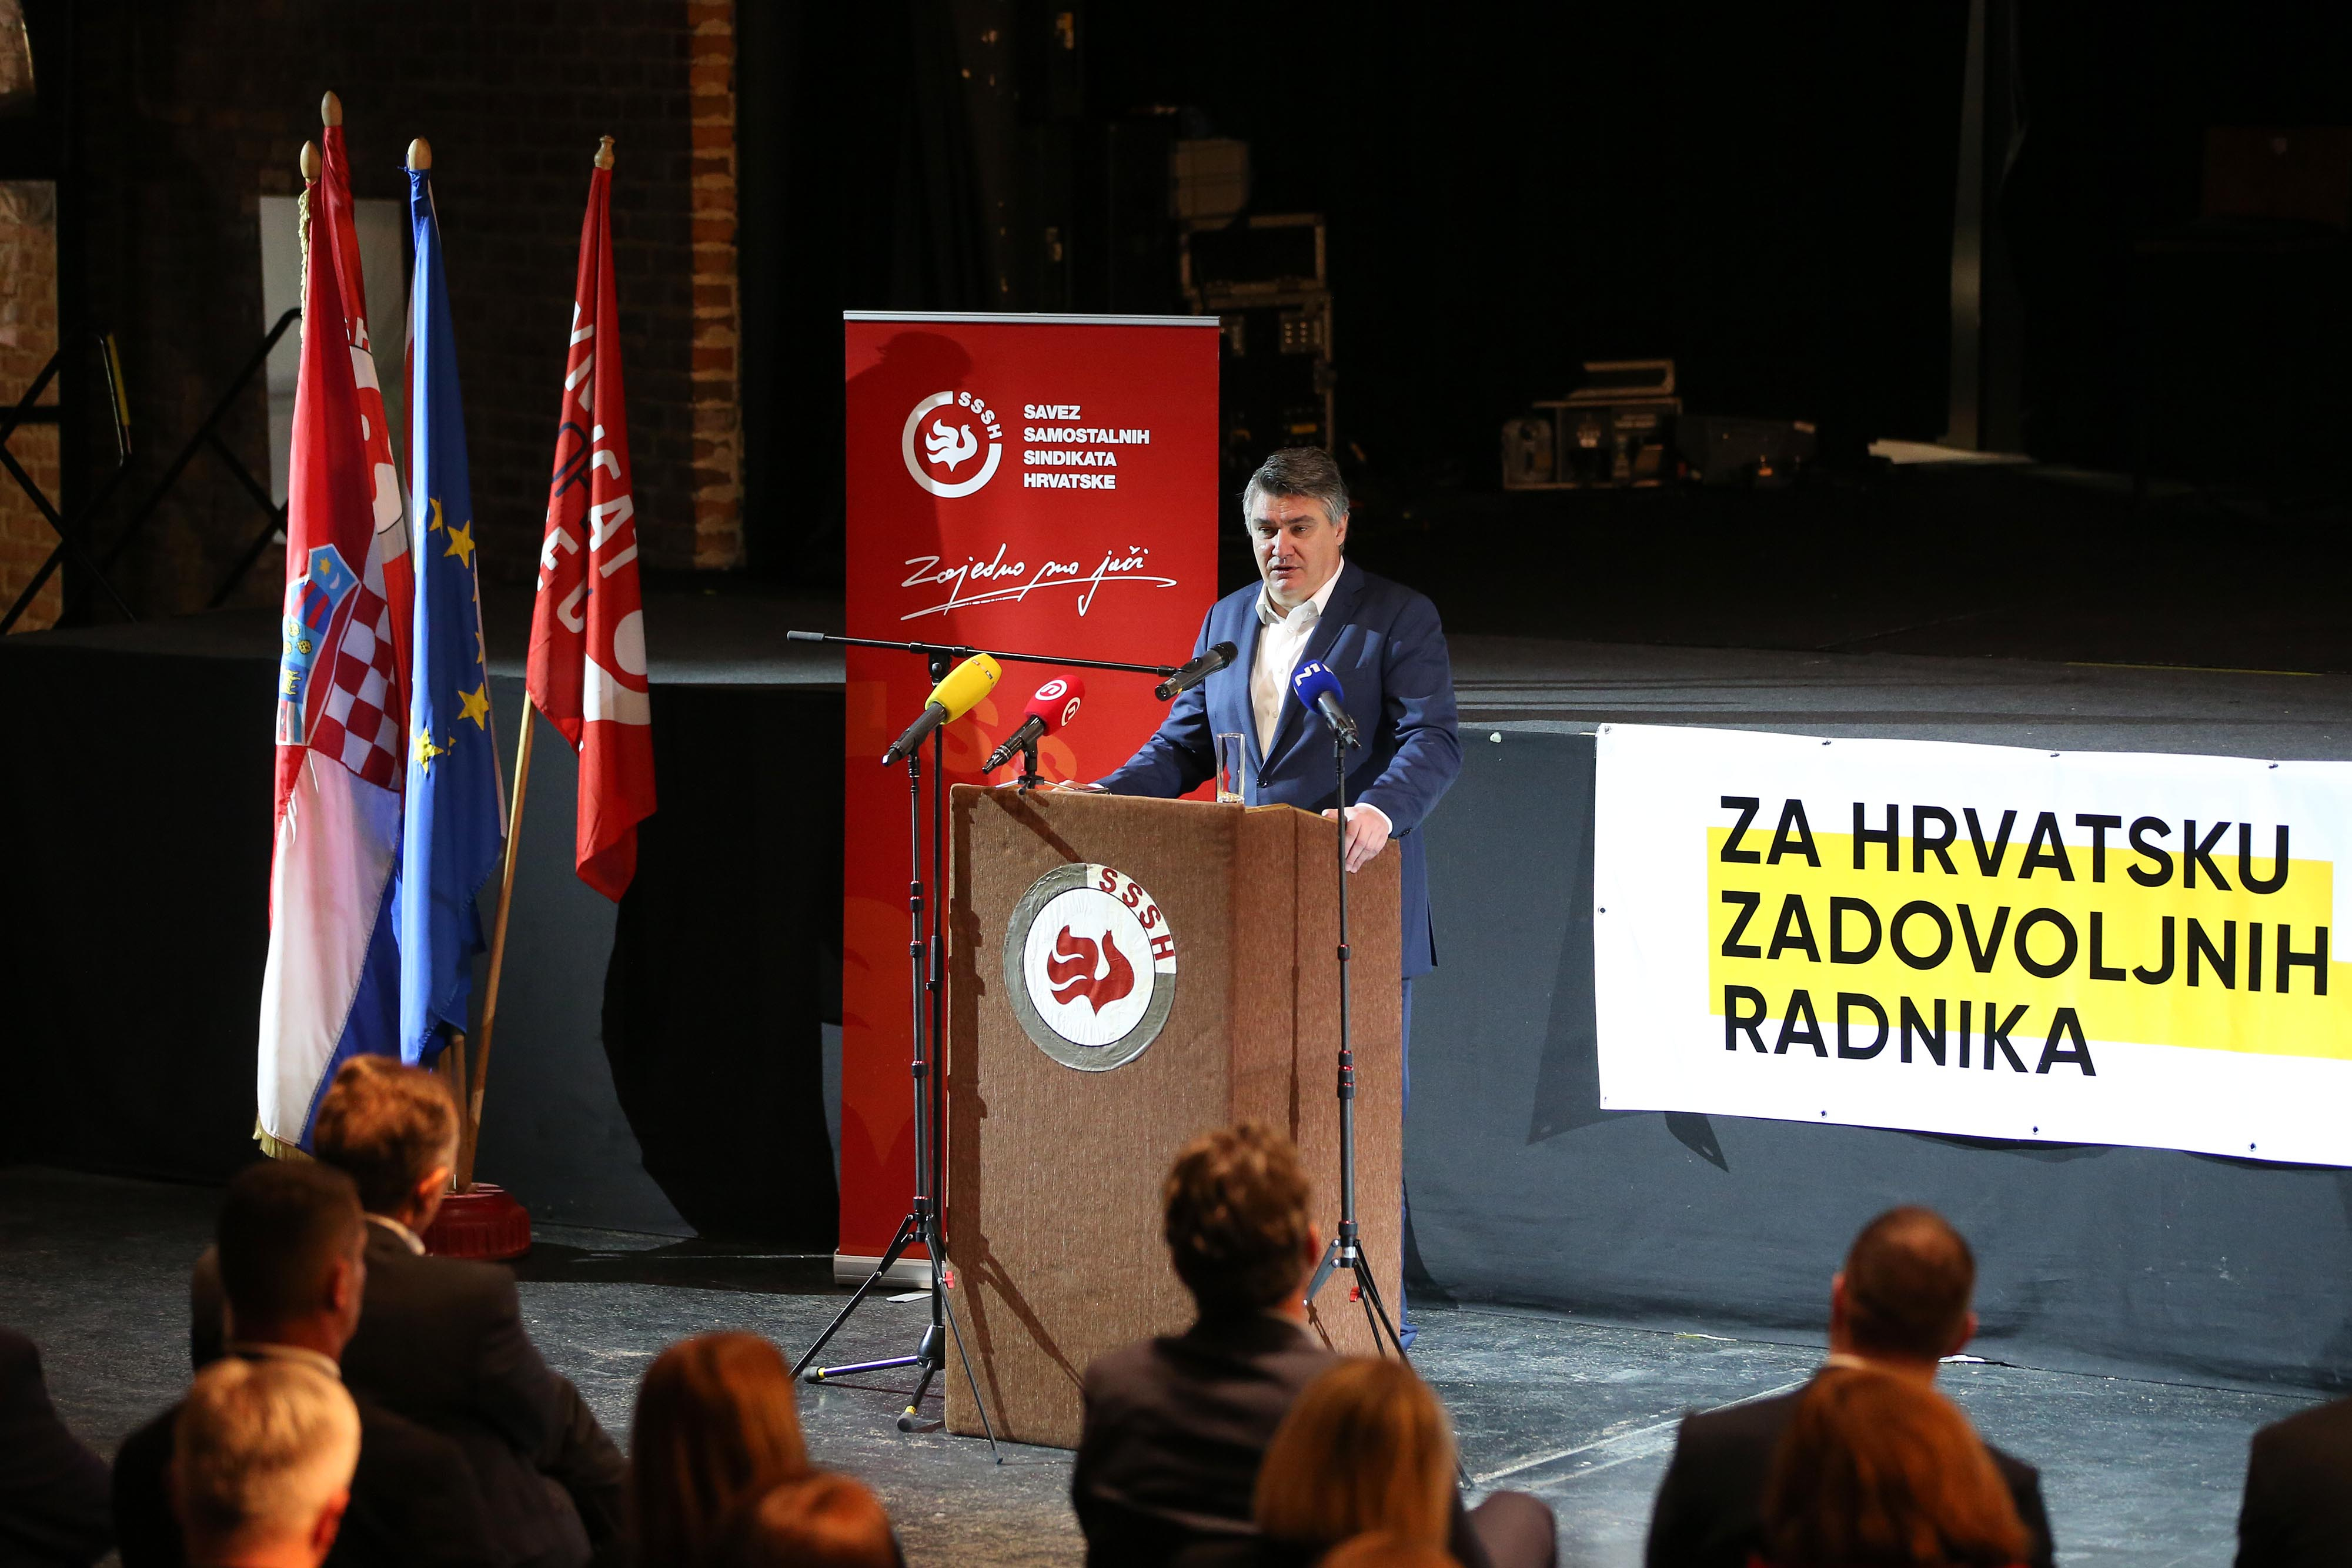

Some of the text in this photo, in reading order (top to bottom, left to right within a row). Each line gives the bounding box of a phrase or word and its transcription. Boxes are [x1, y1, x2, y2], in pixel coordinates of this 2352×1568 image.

[958, 392, 1003, 440] SSSH
[1023, 404, 1081, 420] SAVEZ
[1023, 427, 1150, 444] SAMOSTALNIH
[1023, 450, 1117, 467] SINDIKATA
[1023, 473, 1116, 490] HRVATSKE
[1720, 795, 2288, 895] ZA HRVATSKU
[1099, 867, 1176, 961] SSSH
[1722, 890, 2328, 996] ZADOVOLJNIH
[1724, 984, 2096, 1076] RADNIKA
